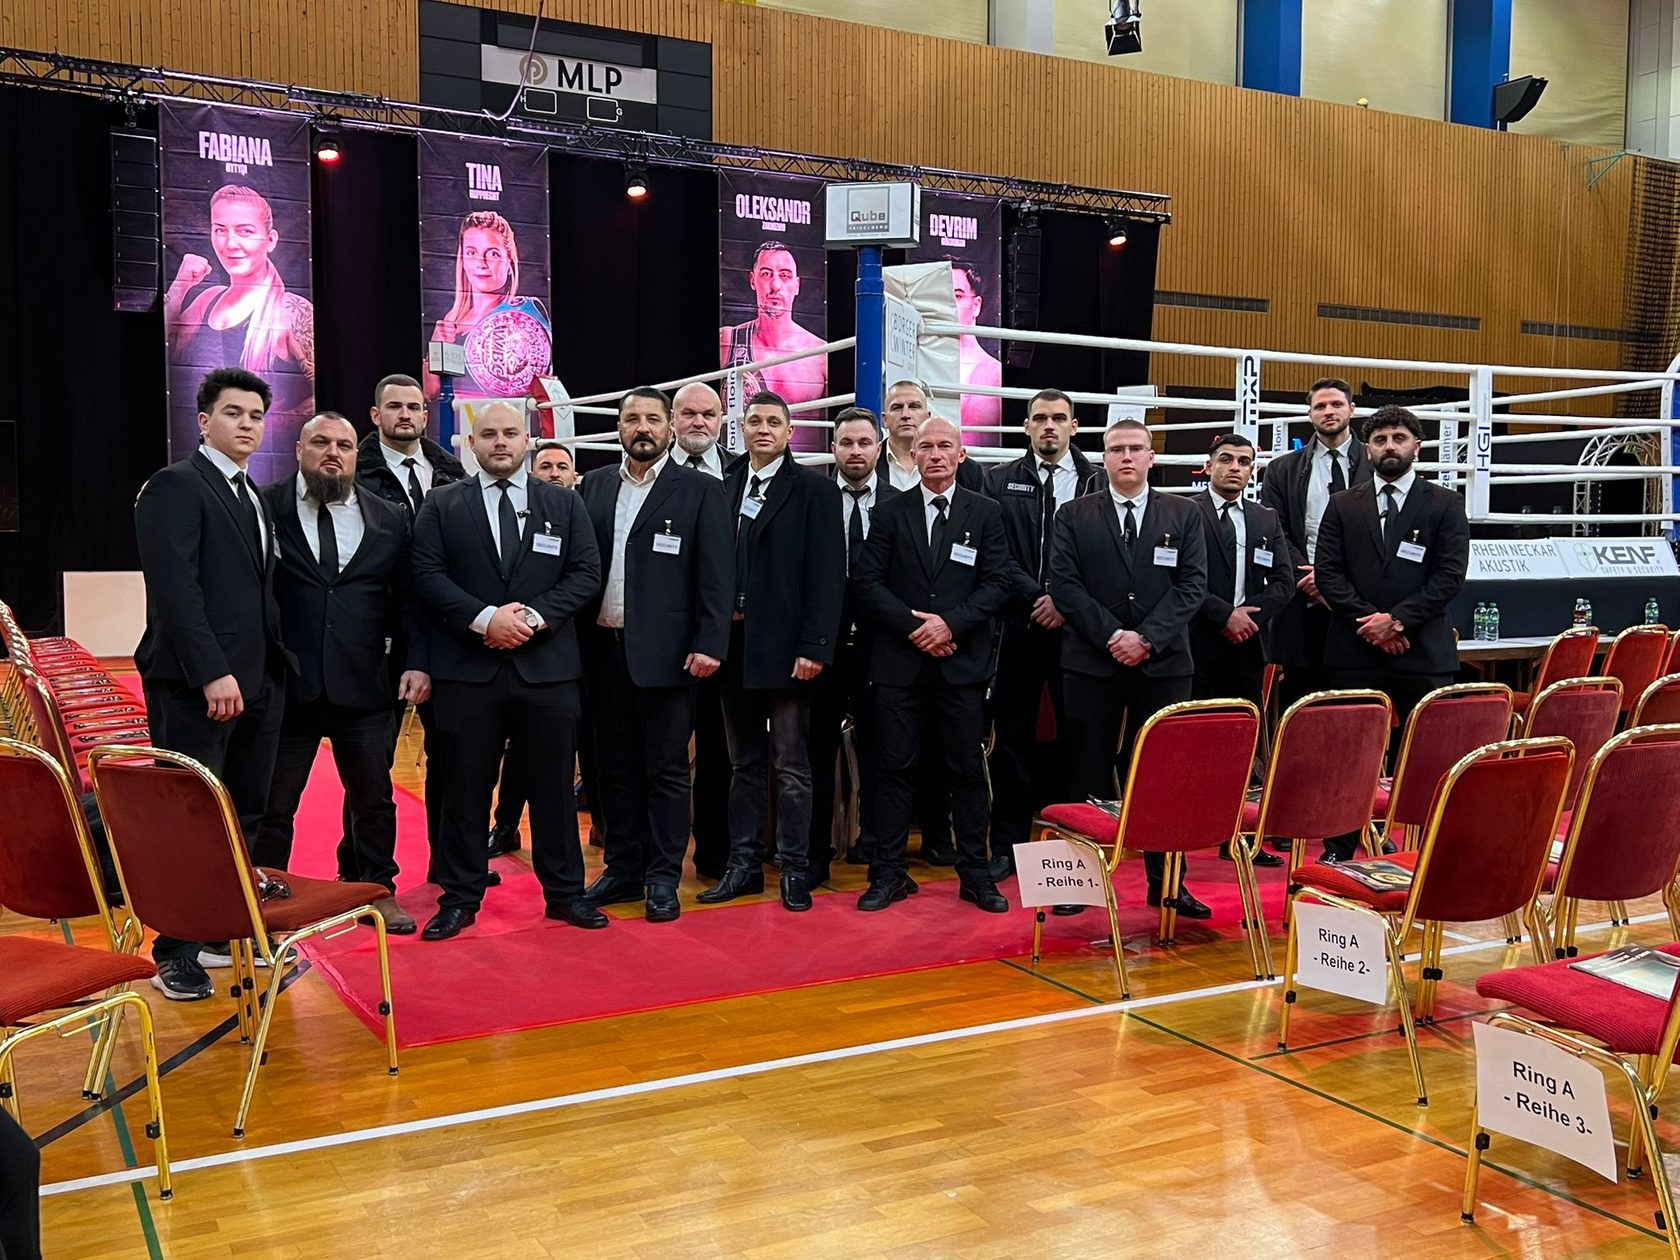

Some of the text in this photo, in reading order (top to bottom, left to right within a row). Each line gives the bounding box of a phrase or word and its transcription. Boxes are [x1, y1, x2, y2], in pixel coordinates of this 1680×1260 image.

[558, 59, 622, 94] MLP
[616, 107, 623, 116] G
[199, 130, 273, 167] FABIANA
[465, 162, 503, 192] TINA
[735, 193, 811, 225] OLEKSANDR
[851, 210, 886, 222] Qube
[929, 213, 978, 240] DEVRIM
[728, 370, 736, 408] floin
[728, 420, 736, 451] loin
[1273, 425, 1282, 452] floin
[1476, 426, 1491, 472] HGI
[1471, 543, 1557, 557] RHEIN NECKAR
[1591, 546, 1656, 565] KENF
[1479, 559, 1531, 573] AKUSTIK
[1042, 858, 1086, 871] Ring A
[1045, 876, 1084, 888] Reihe
[1318, 927, 1359, 949] Ring A
[1321, 952, 1355, 972] Reihe
[1513, 1060, 1576, 1100] Ring A
[1516, 1092, 1570, 1127] Reihe
